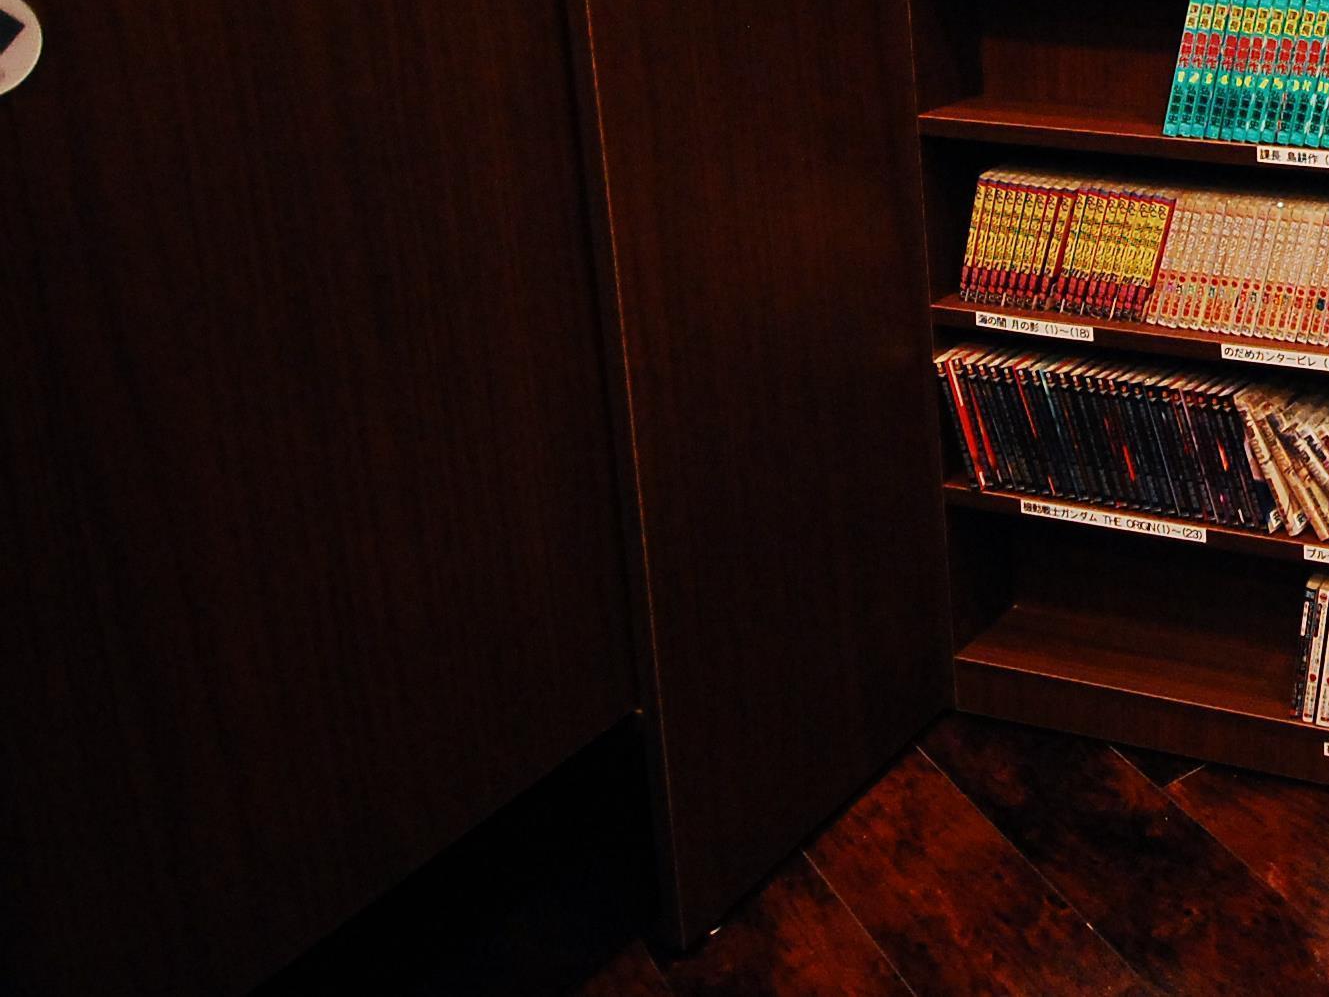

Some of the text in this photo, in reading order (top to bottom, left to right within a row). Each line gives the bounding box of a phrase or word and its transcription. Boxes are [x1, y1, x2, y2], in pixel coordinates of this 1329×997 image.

[1224, 347, 1317, 367] のだめカンタービレ
